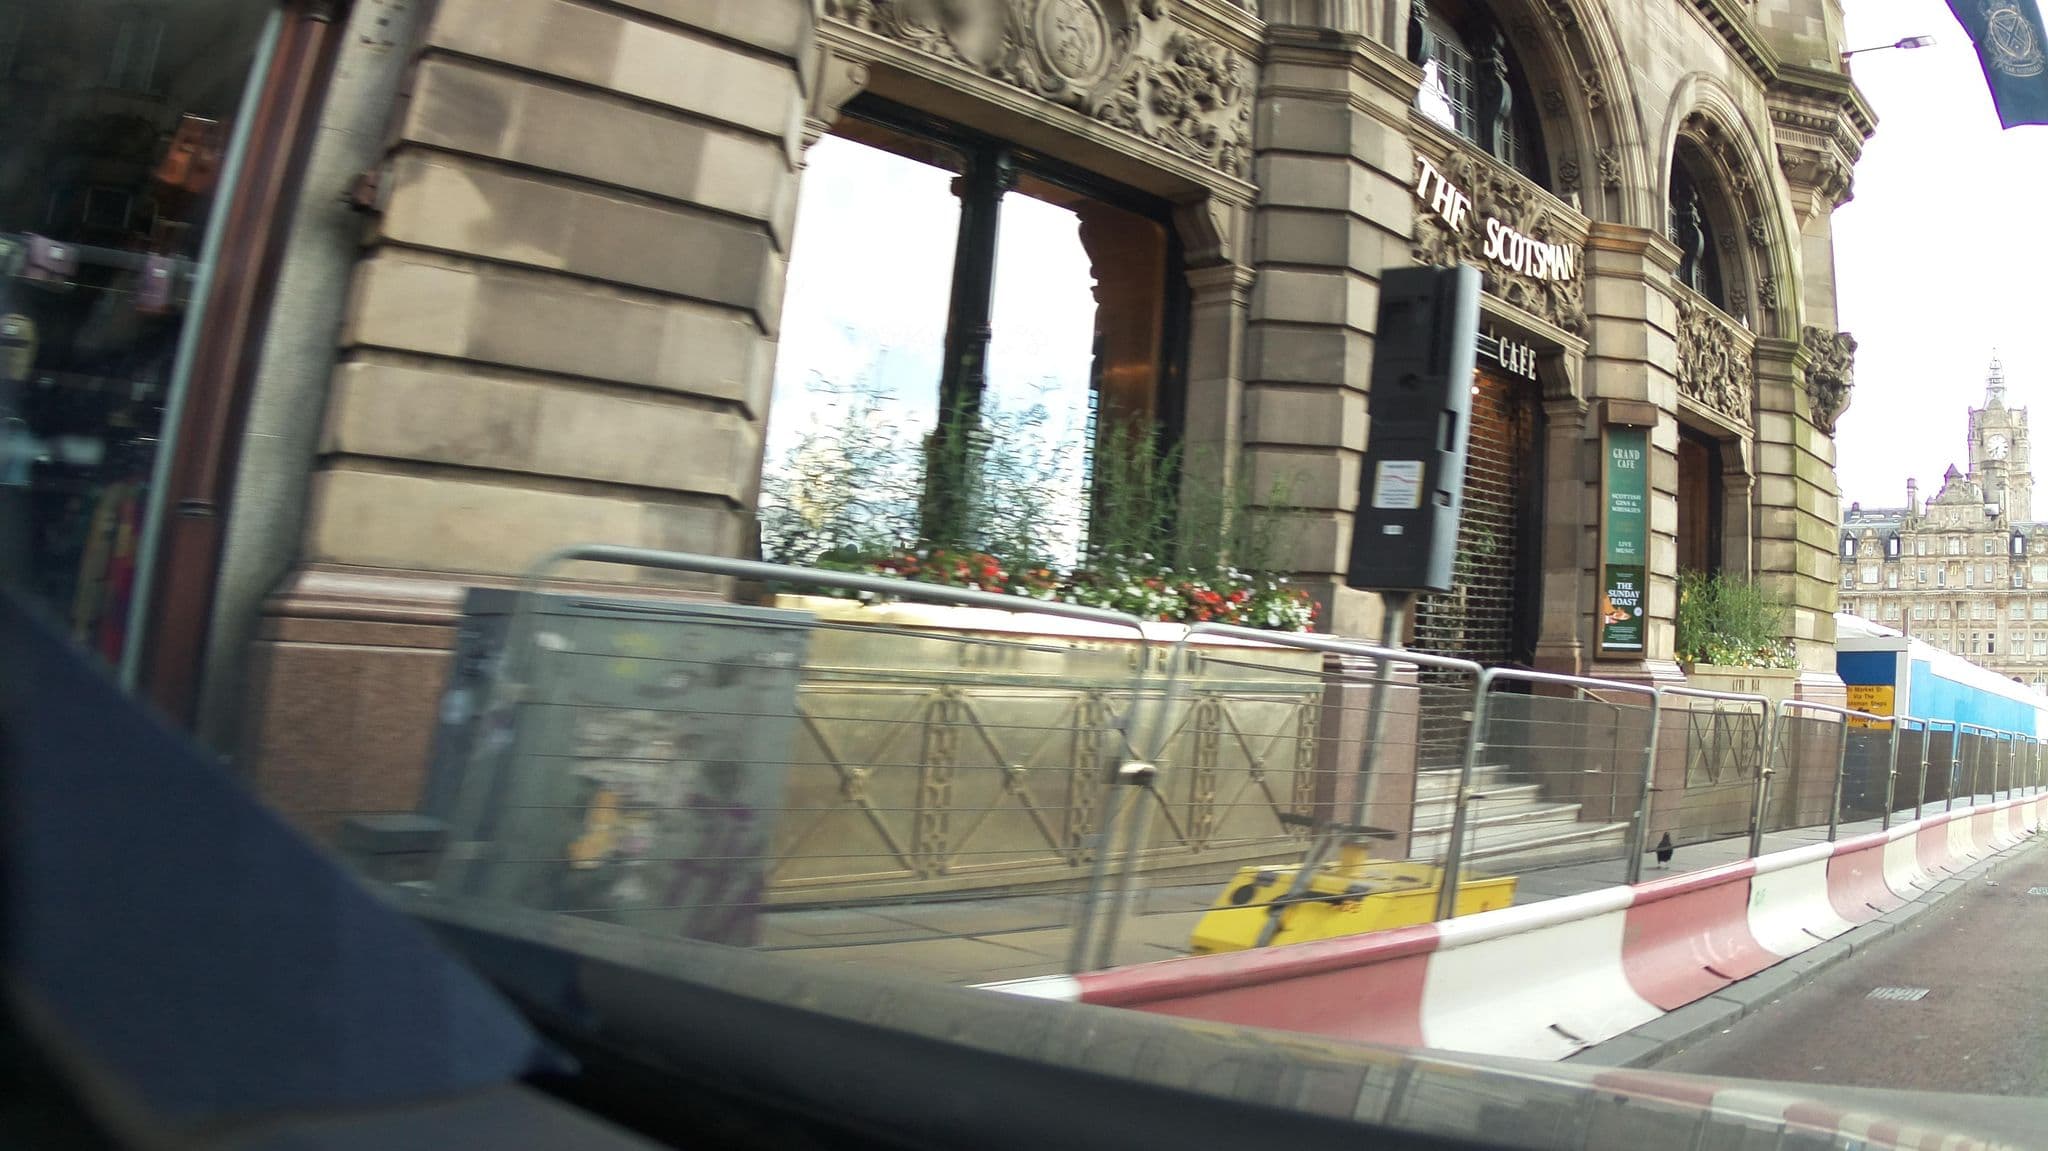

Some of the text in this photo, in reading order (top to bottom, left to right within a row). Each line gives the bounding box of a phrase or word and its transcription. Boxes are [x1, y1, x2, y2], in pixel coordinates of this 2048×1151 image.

[1416, 155, 1472, 232] THE
[1483, 217, 1575, 280] SCOTSMAN
[1499, 336, 1536, 381] CAFE
[1612, 447, 1640, 460] GRAND
[1617, 459, 1635, 469] CAFE
[1616, 582, 1633, 590] THE
[1608, 590, 1640, 599] SUNDAY
[1611, 598, 1638, 606] ROAST
